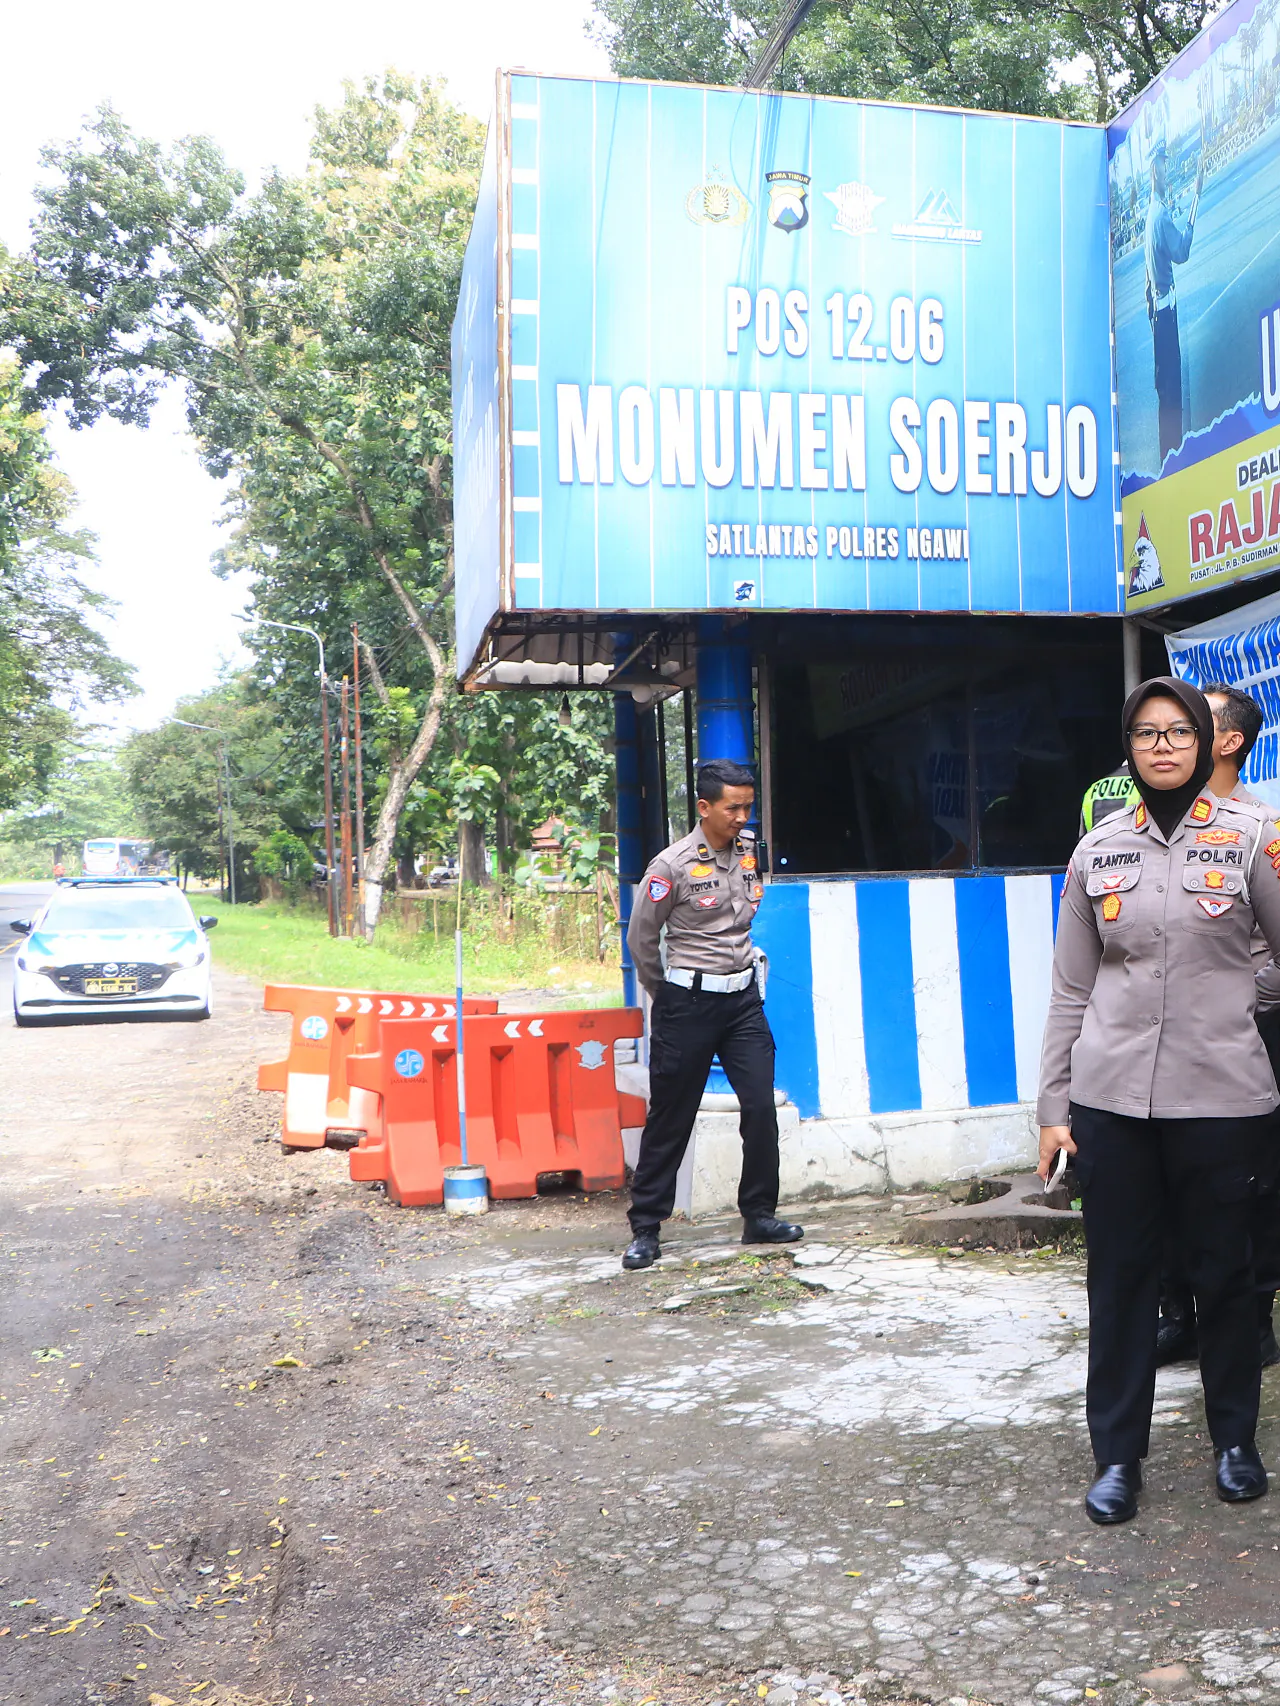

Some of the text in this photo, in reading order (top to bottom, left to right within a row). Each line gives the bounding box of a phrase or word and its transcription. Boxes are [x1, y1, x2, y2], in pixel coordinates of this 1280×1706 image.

[787, 172, 809, 184] TIMUR
[727, 287, 945, 364] POS 12.06
[556, 383, 866, 490] MONUMEN
[890, 398, 1098, 498] SOERJO
[706, 523, 969, 560] SATLANTAS POLRES NGAWI
[1190, 569, 1210, 582] PUSAT
[1215, 564, 1225, 574] JL.
[1241, 545, 1279, 564] SUDIRMAN
[1091, 777, 1135, 799] POLISI
[1092, 851, 1141, 869] PLANTIKA
[1186, 849, 1243, 865] POLRI
